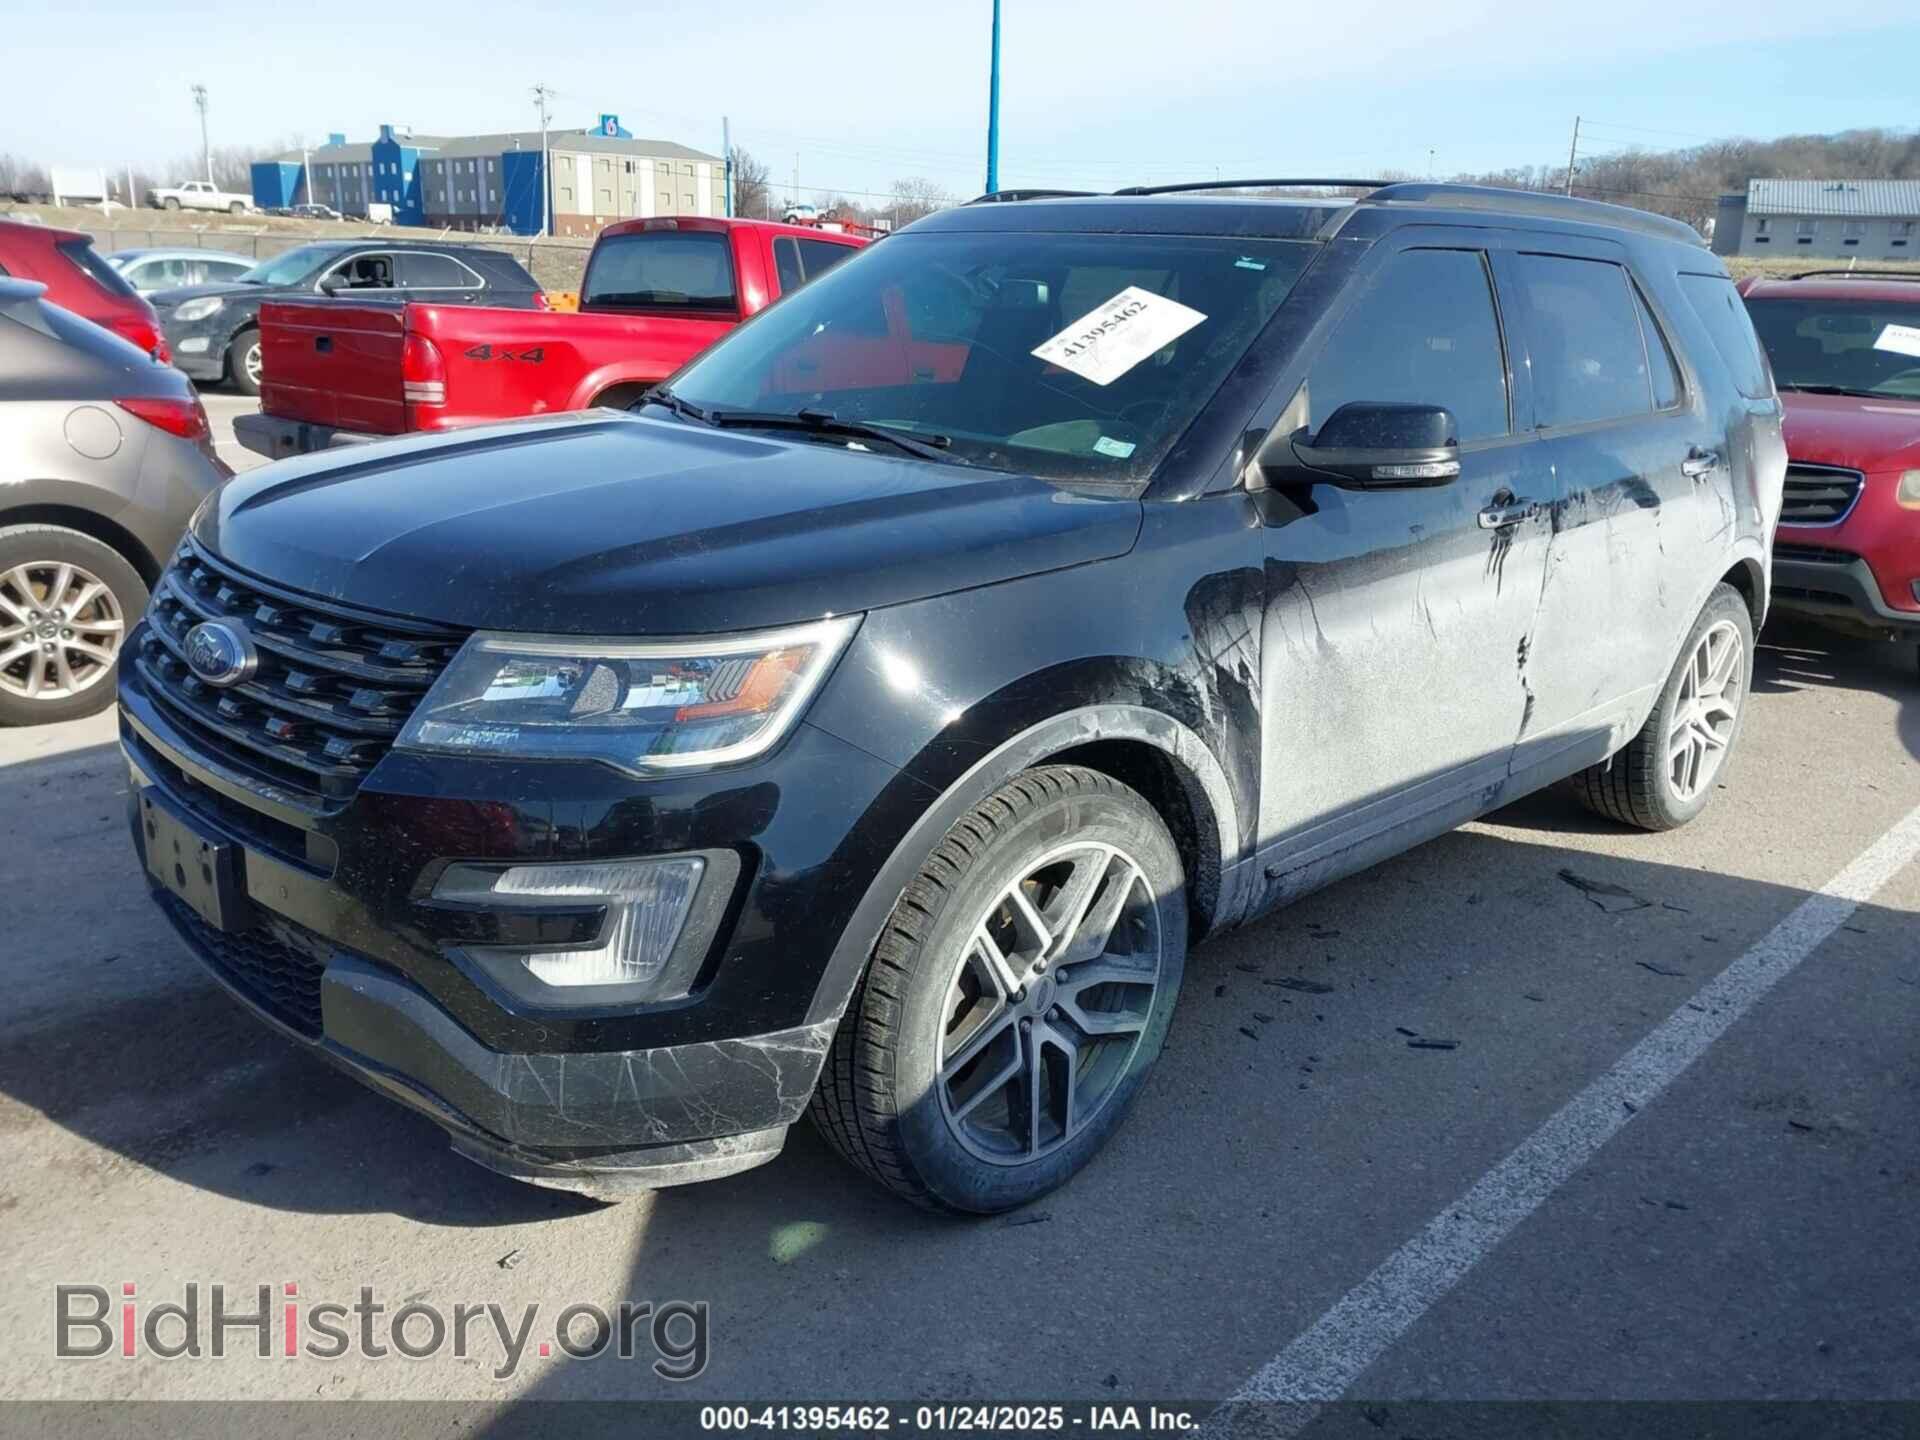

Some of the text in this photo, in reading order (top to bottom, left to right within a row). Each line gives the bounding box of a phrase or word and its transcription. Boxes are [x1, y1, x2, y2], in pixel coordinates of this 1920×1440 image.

[607, 117, 617, 136] 6
[1063, 301, 1148, 357] 41395462
[191, 630, 222, 670] Ford
